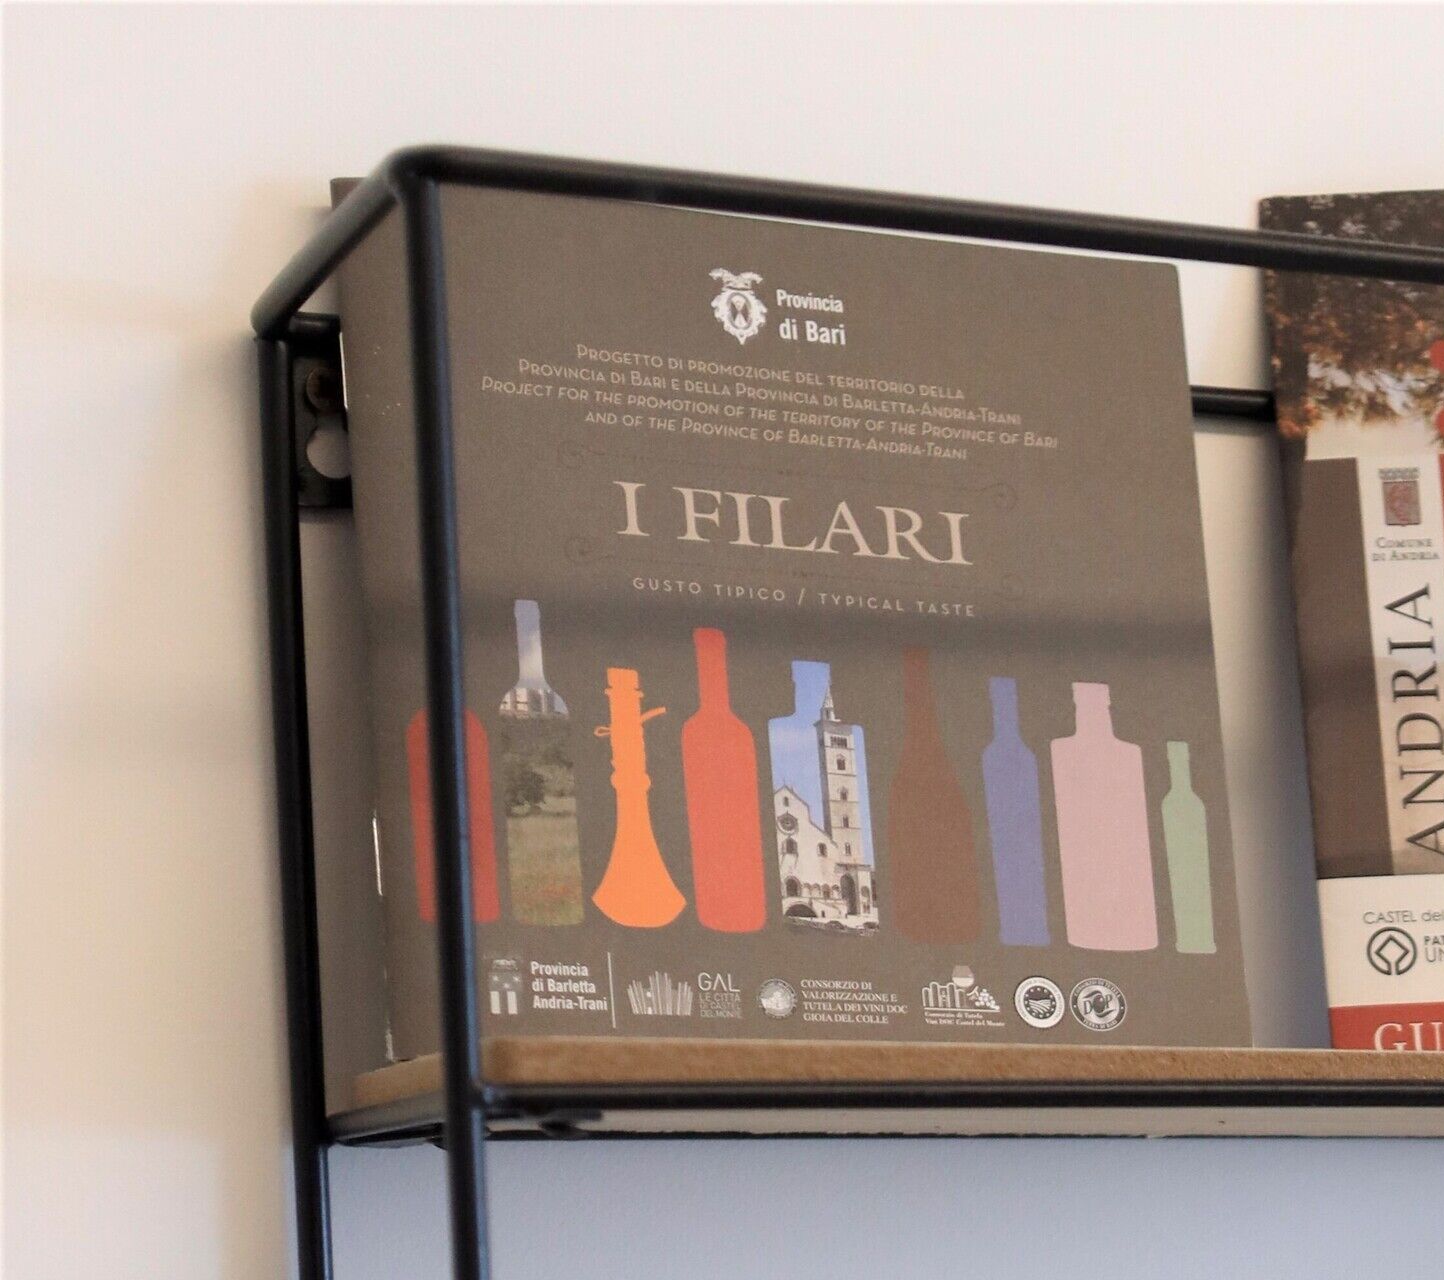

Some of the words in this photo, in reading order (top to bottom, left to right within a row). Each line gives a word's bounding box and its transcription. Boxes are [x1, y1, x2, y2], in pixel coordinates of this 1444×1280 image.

[776, 289, 843, 313] Provincia
[779, 318, 798, 340] di
[805, 320, 846, 345] Bari
[577, 344, 663, 367] PROGETTO
[668, 357, 683, 370] DI
[689, 360, 790, 383] PROMOZIONE
[796, 371, 823, 385] DEL
[828, 375, 915, 395] TERRITORIO
[920, 385, 965, 400] DELLA
[519, 358, 605, 382] PROVINCIA
[611, 371, 625, 384] DI
[631, 371, 665, 389] BARI
[672, 378, 680, 391] E
[685, 379, 731, 396] DELLA
[736, 383, 818, 406] PROVINCIA
[823, 395, 838, 407] DI
[842, 393, 1022, 425] BARLETTA-ANDRIA-TRANI
[482, 376, 552, 397] PROJECT
[558, 387, 589, 401] FOR
[595, 390, 622, 405] THE
[628, 395, 720, 416] PROMOTION
[724, 404, 745, 418] OF
[749, 408, 777, 422] THE
[783, 411, 859, 430] TERRITORY
[865, 419, 886, 433] OF
[890, 422, 916, 436] THE
[922, 422, 995, 443] PROVINCE
[999, 432, 1020, 446] OF
[1024, 432, 1058, 448] BARI
[585, 411, 617, 426] AND
[622, 414, 643, 428] OF
[648, 417, 676, 432] THE
[682, 417, 758, 441] PROVINCE
[763, 429, 784, 443] OF
[789, 429, 967, 460] BARLETTA-ANDRIA-TRANI
[613, 481, 651, 537] I
[672, 487, 973, 566] FILARI
[632, 577, 702, 595] GUSTO
[714, 584, 786, 602] TIPICO
[798, 588, 806, 606] /
[818, 592, 904, 612] TYPICAL
[916, 600, 975, 617] TASTE
[1363, 910, 1417, 925] CASTEL
[1421, 910, 1444, 922] del
[530, 961, 589, 977] Provincia
[532, 977, 545, 993] di
[547, 978, 596, 994] Barletta
[698, 972, 741, 992] GAL
[801, 979, 859, 990] CONSORZIO
[861, 981, 872, 990] DI
[533, 995, 608, 1012] Andria-Trani
[802, 991, 889, 1002] VALORIZZAZIONE
[891, 993, 897, 1002] E
[803, 1001, 843, 1011] TUTELA
[844, 1003, 861, 1012] DEI
[864, 1004, 884, 1012] VINI
[887, 1005, 908, 1014] DOC
[804, 1013, 833, 1022] GIOIA
[834, 1014, 852, 1023] DEL
[856, 1014, 888, 1024] COLLE
